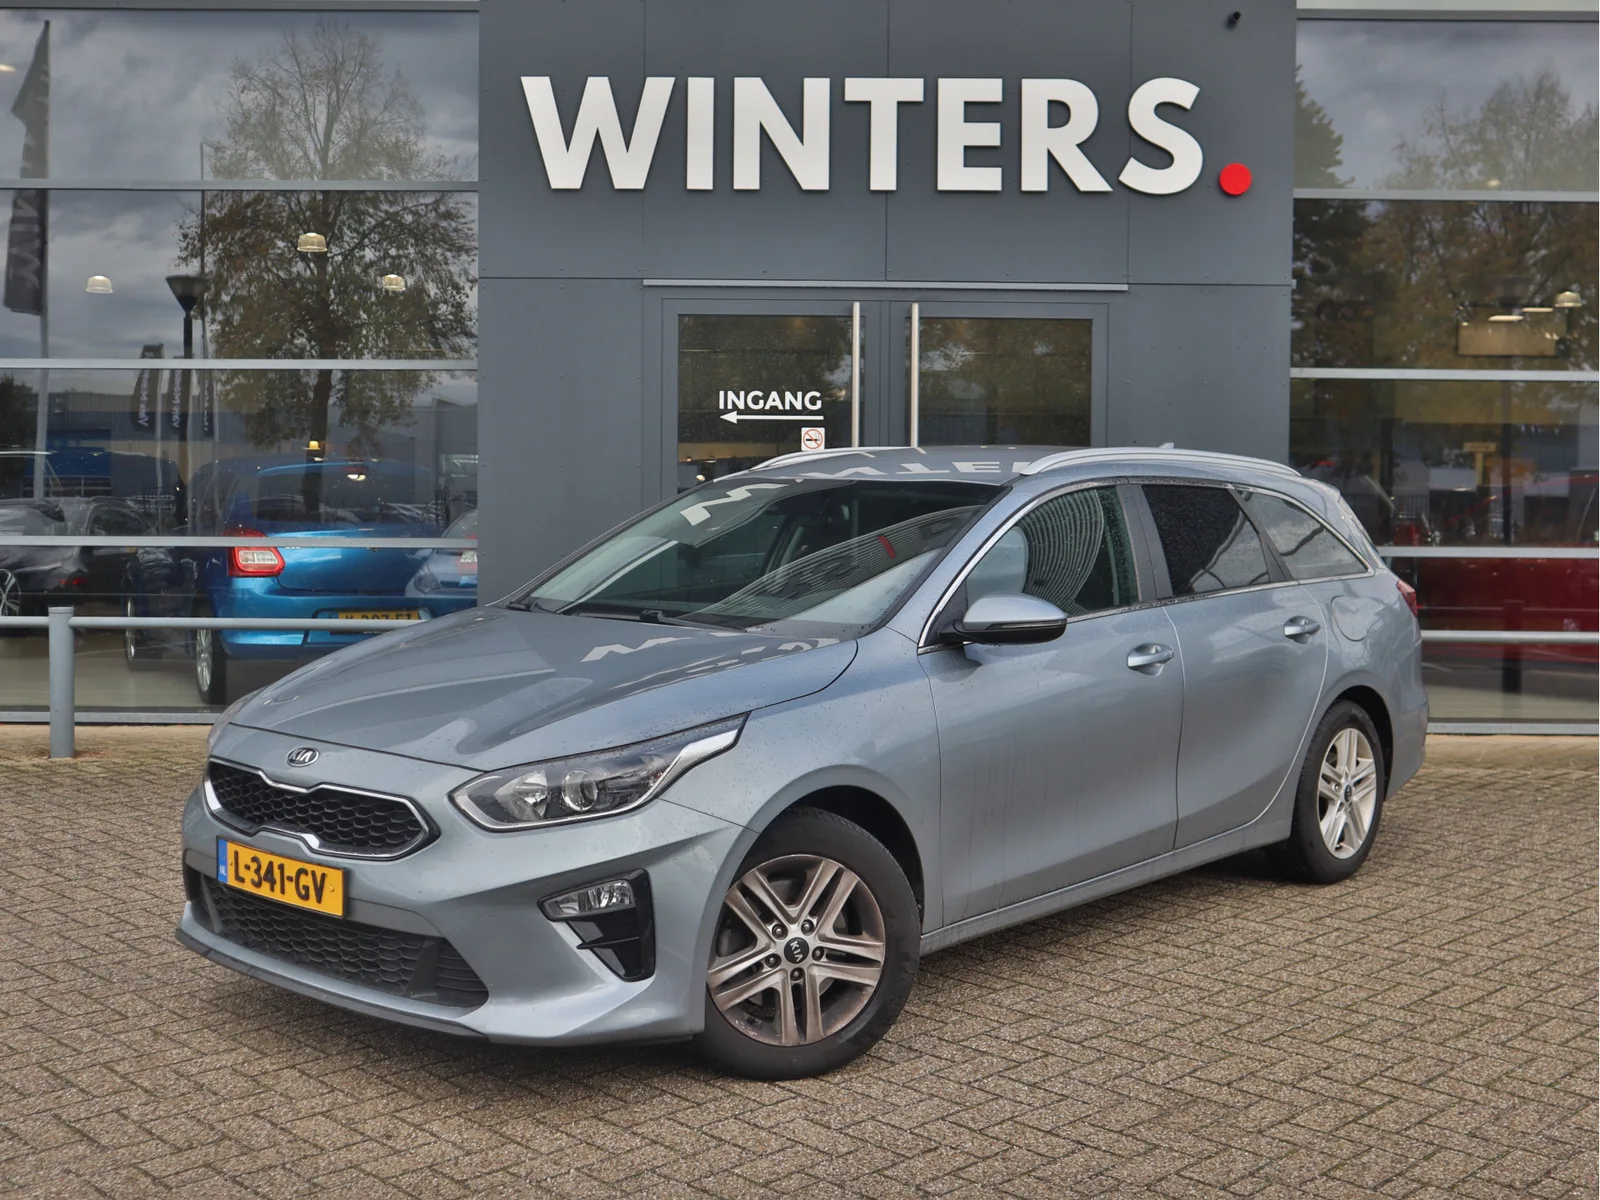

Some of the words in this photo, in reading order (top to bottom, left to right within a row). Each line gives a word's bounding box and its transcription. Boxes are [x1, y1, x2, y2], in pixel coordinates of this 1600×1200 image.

[719, 390, 822, 411] INGANG
[288, 748, 314, 763] KIA
[219, 864, 228, 876] NL
[233, 850, 327, 905] L-341-GV
[790, 940, 804, 962] KIA
